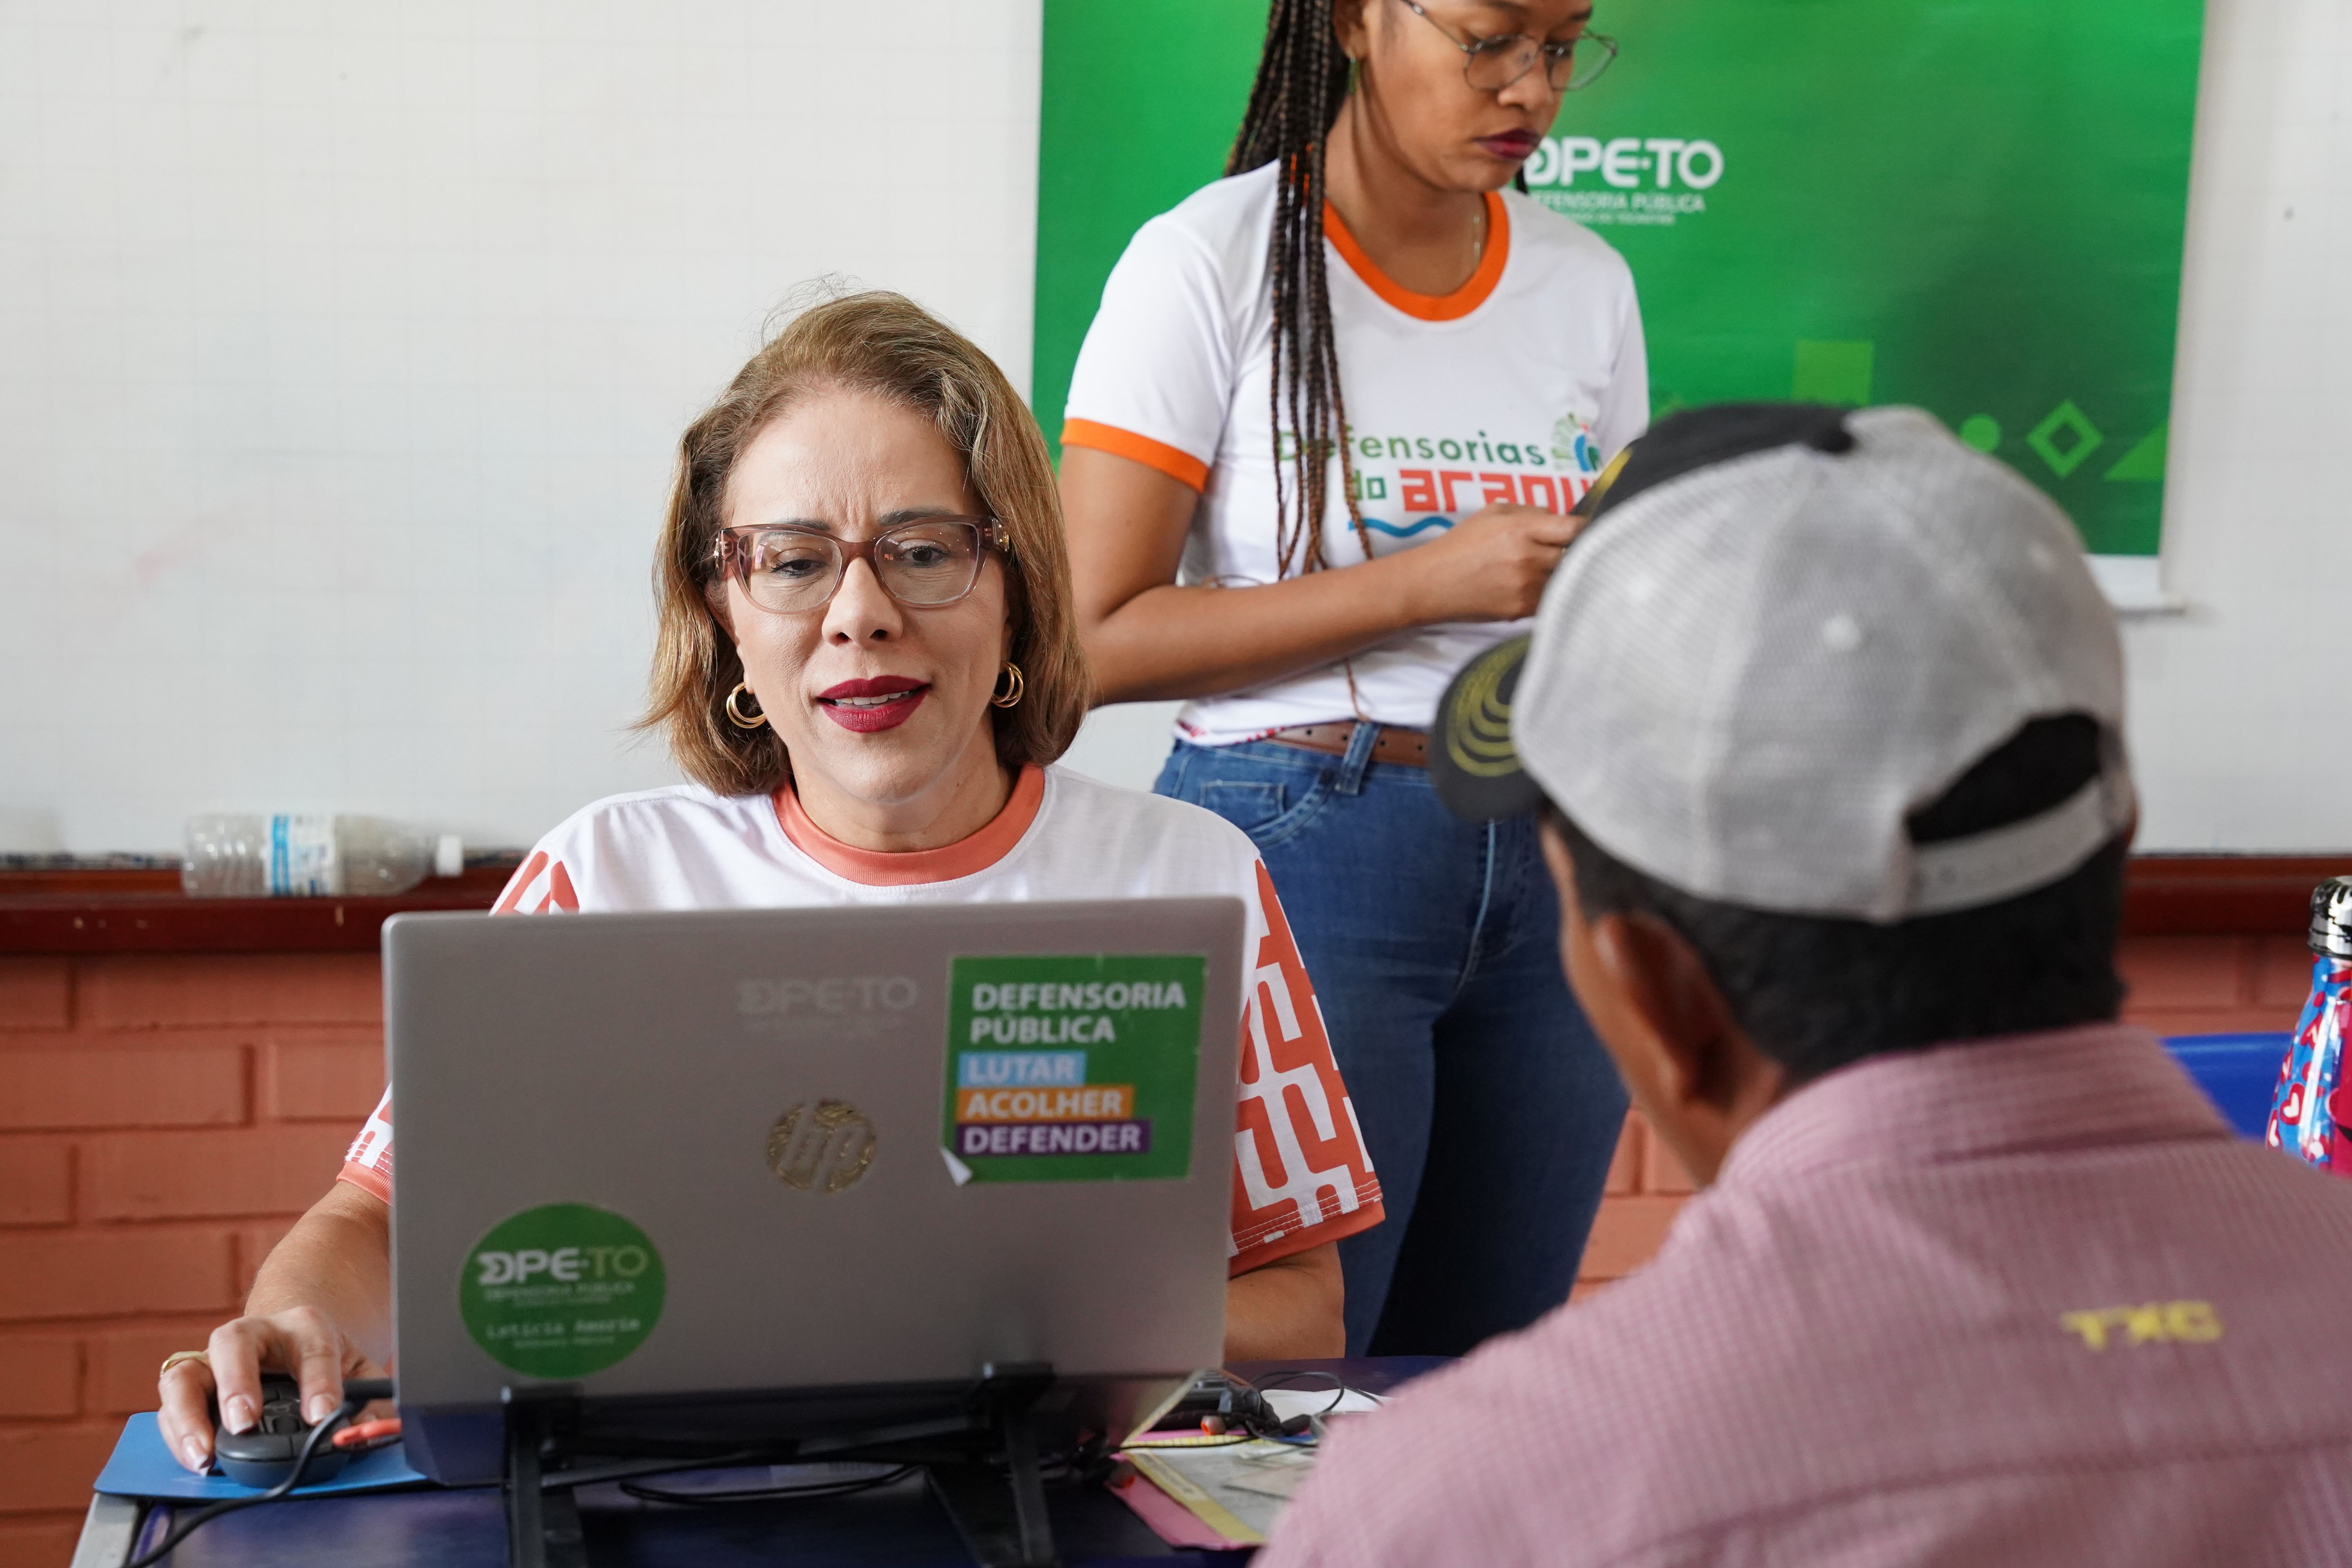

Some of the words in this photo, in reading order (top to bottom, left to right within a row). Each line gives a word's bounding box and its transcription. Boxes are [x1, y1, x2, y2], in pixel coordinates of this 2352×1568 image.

[1274, 426, 1546, 466] Densorias
[972, 981, 1187, 1011] DEFENSORIA
[970, 1011, 1116, 1044] PÚBLICA
[967, 1054, 1075, 1084] LUTAR
[966, 1090, 1123, 1118] ACOLHER
[963, 1123, 1142, 1154] DEFENDER
